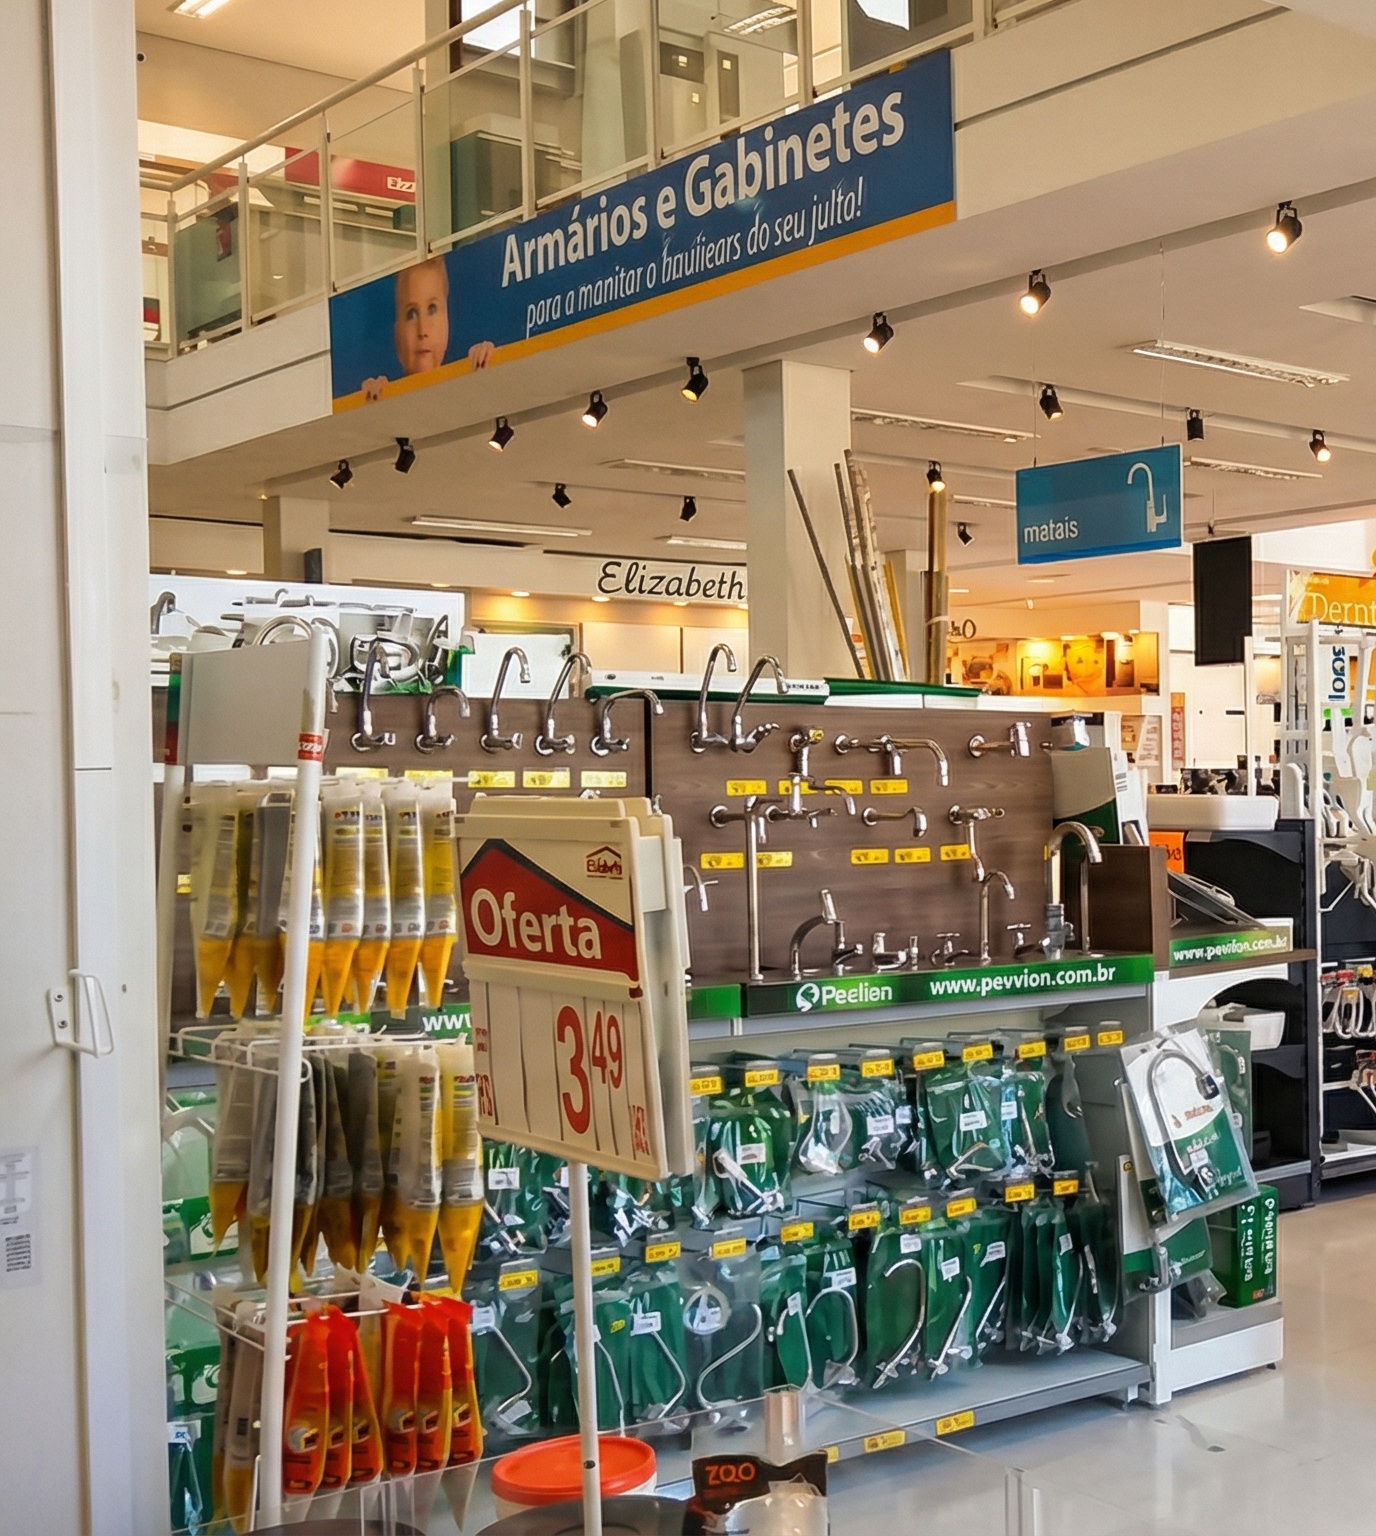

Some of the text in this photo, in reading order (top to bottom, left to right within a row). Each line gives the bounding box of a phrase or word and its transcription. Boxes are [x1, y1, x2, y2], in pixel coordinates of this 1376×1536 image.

[502, 91, 905, 288] Armários e Gabinetes
[526, 295, 561, 339] para
[565, 290, 575, 316] a
[578, 266, 643, 312] manitar
[646, 262, 657, 289] o
[747, 209, 770, 256] do
[774, 209, 806, 246] seu
[597, 560, 746, 600] Elizabeth
[1024, 516, 1079, 544] matais
[470, 888, 602, 960] Oferta
[557, 1005, 591, 1135] 3
[591, 1010, 622, 1090] 49
